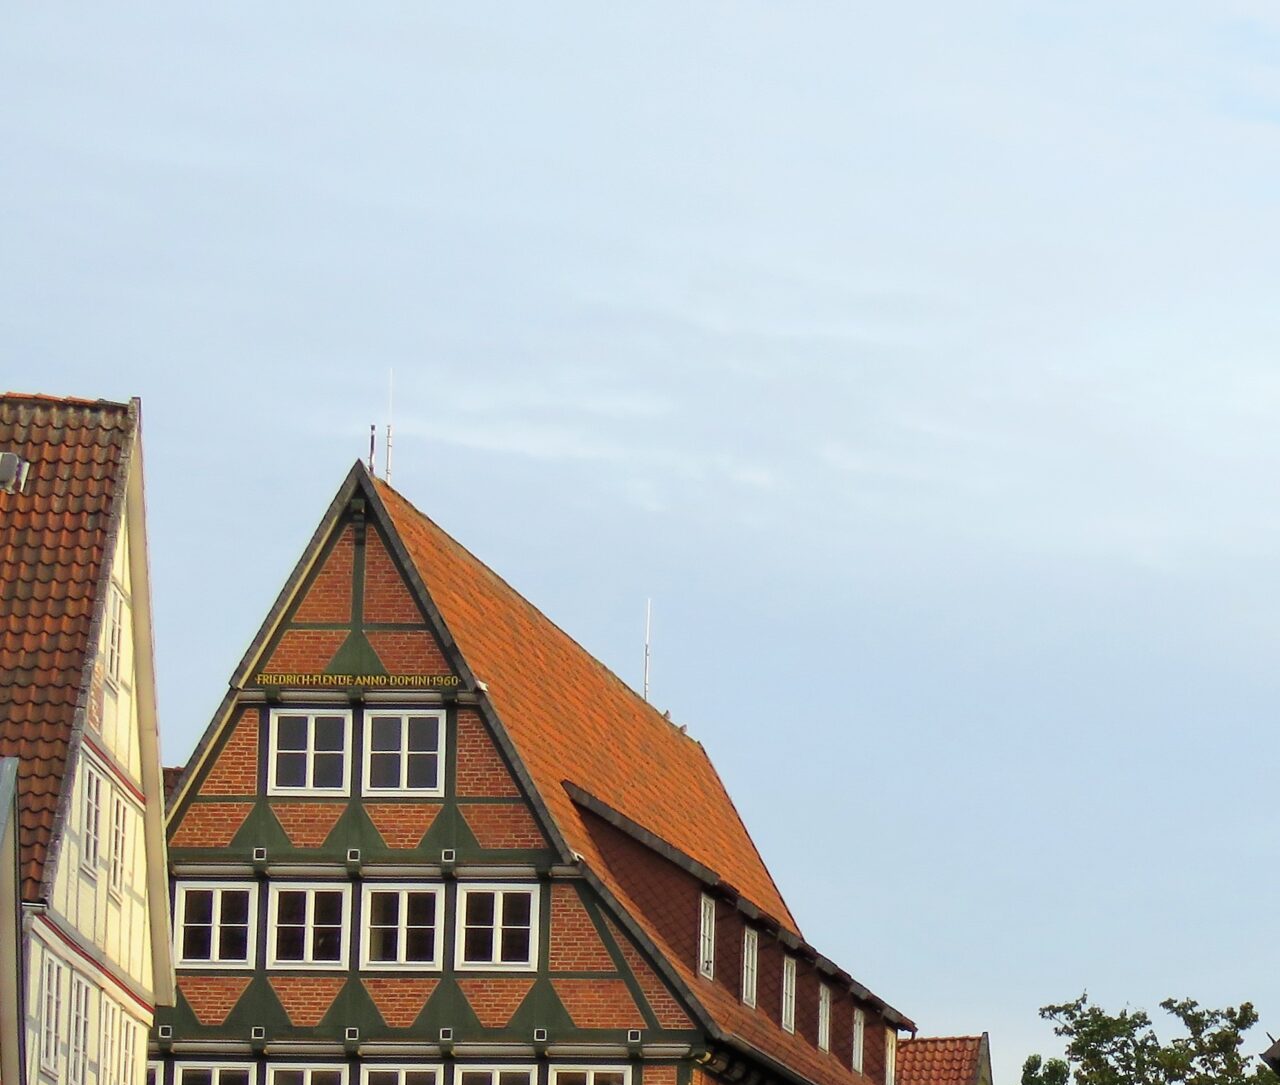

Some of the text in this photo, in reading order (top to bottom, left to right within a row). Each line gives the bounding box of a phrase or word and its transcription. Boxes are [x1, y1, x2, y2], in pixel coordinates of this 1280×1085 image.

[354, 675, 386, 686] ANNO
[390, 675, 430, 686] DOMINI
[432, 675, 459, 686] 1960
